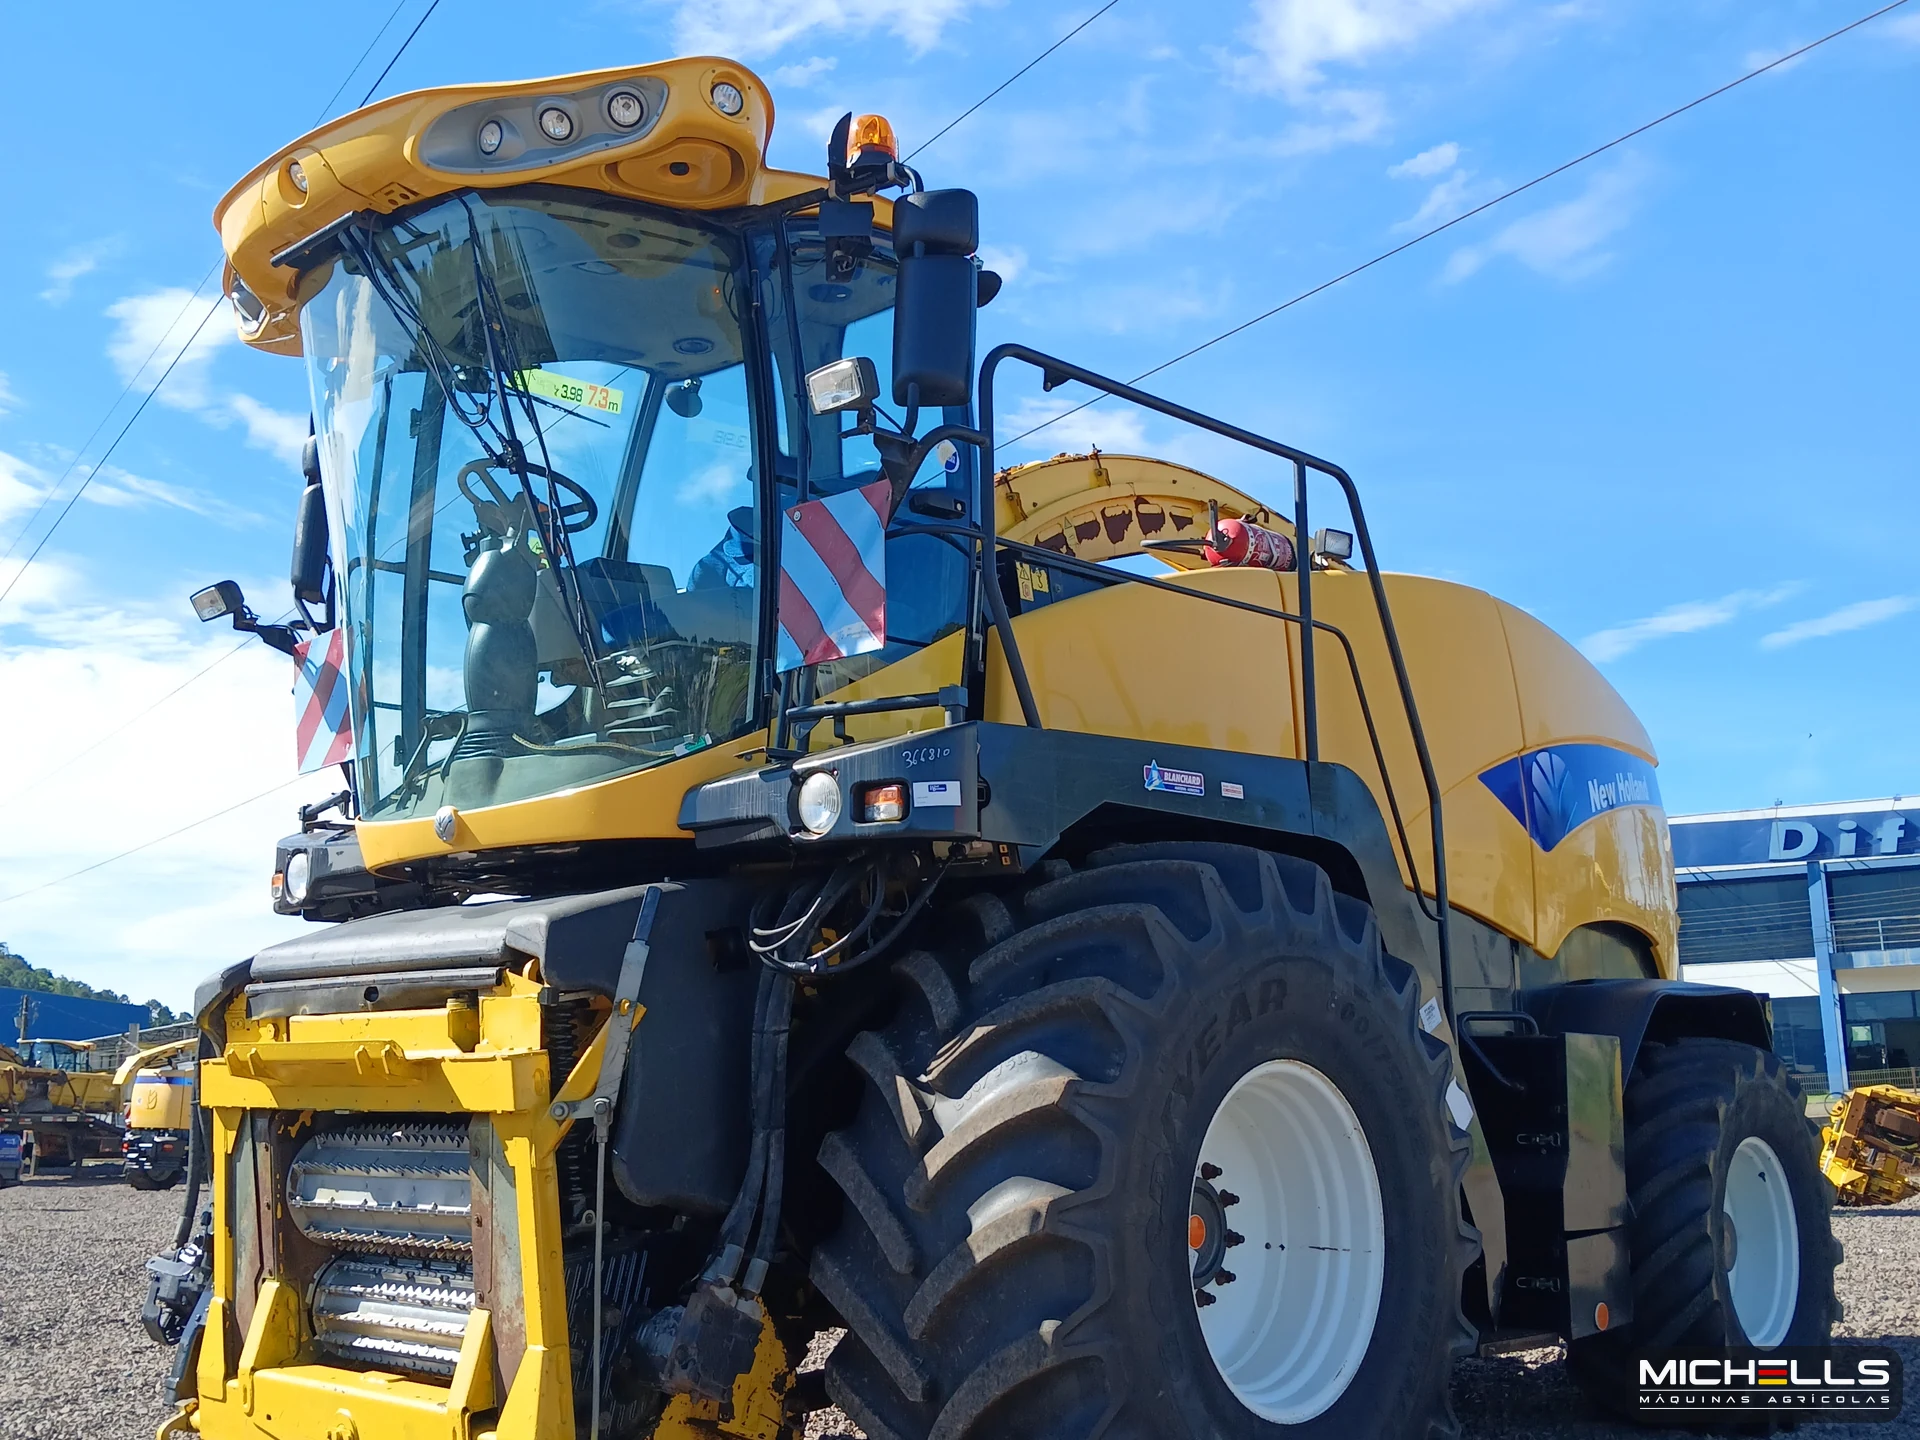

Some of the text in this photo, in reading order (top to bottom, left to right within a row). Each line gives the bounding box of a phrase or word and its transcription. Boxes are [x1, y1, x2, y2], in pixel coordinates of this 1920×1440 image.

[1163, 771, 1201, 786] BLANCHARD
[1587, 772, 1650, 813] New Holland
